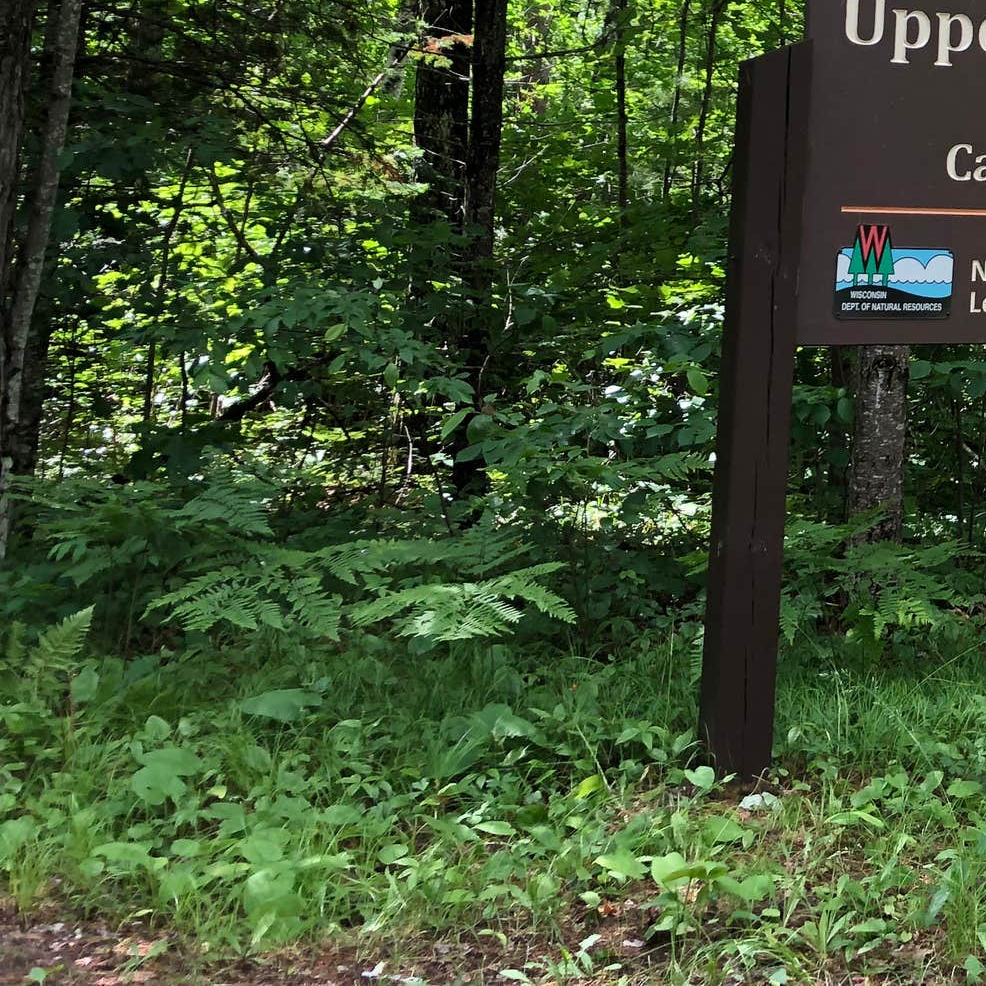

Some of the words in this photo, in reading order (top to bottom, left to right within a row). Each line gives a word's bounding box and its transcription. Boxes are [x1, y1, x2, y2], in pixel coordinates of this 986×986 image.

[850, 291, 887, 299] WISCONSIN
[841, 302, 860, 311] DEPT.
[861, 302, 871, 311] OF
[871, 303, 902, 311] NATURAL
[902, 303, 942, 311] RESOURCES
